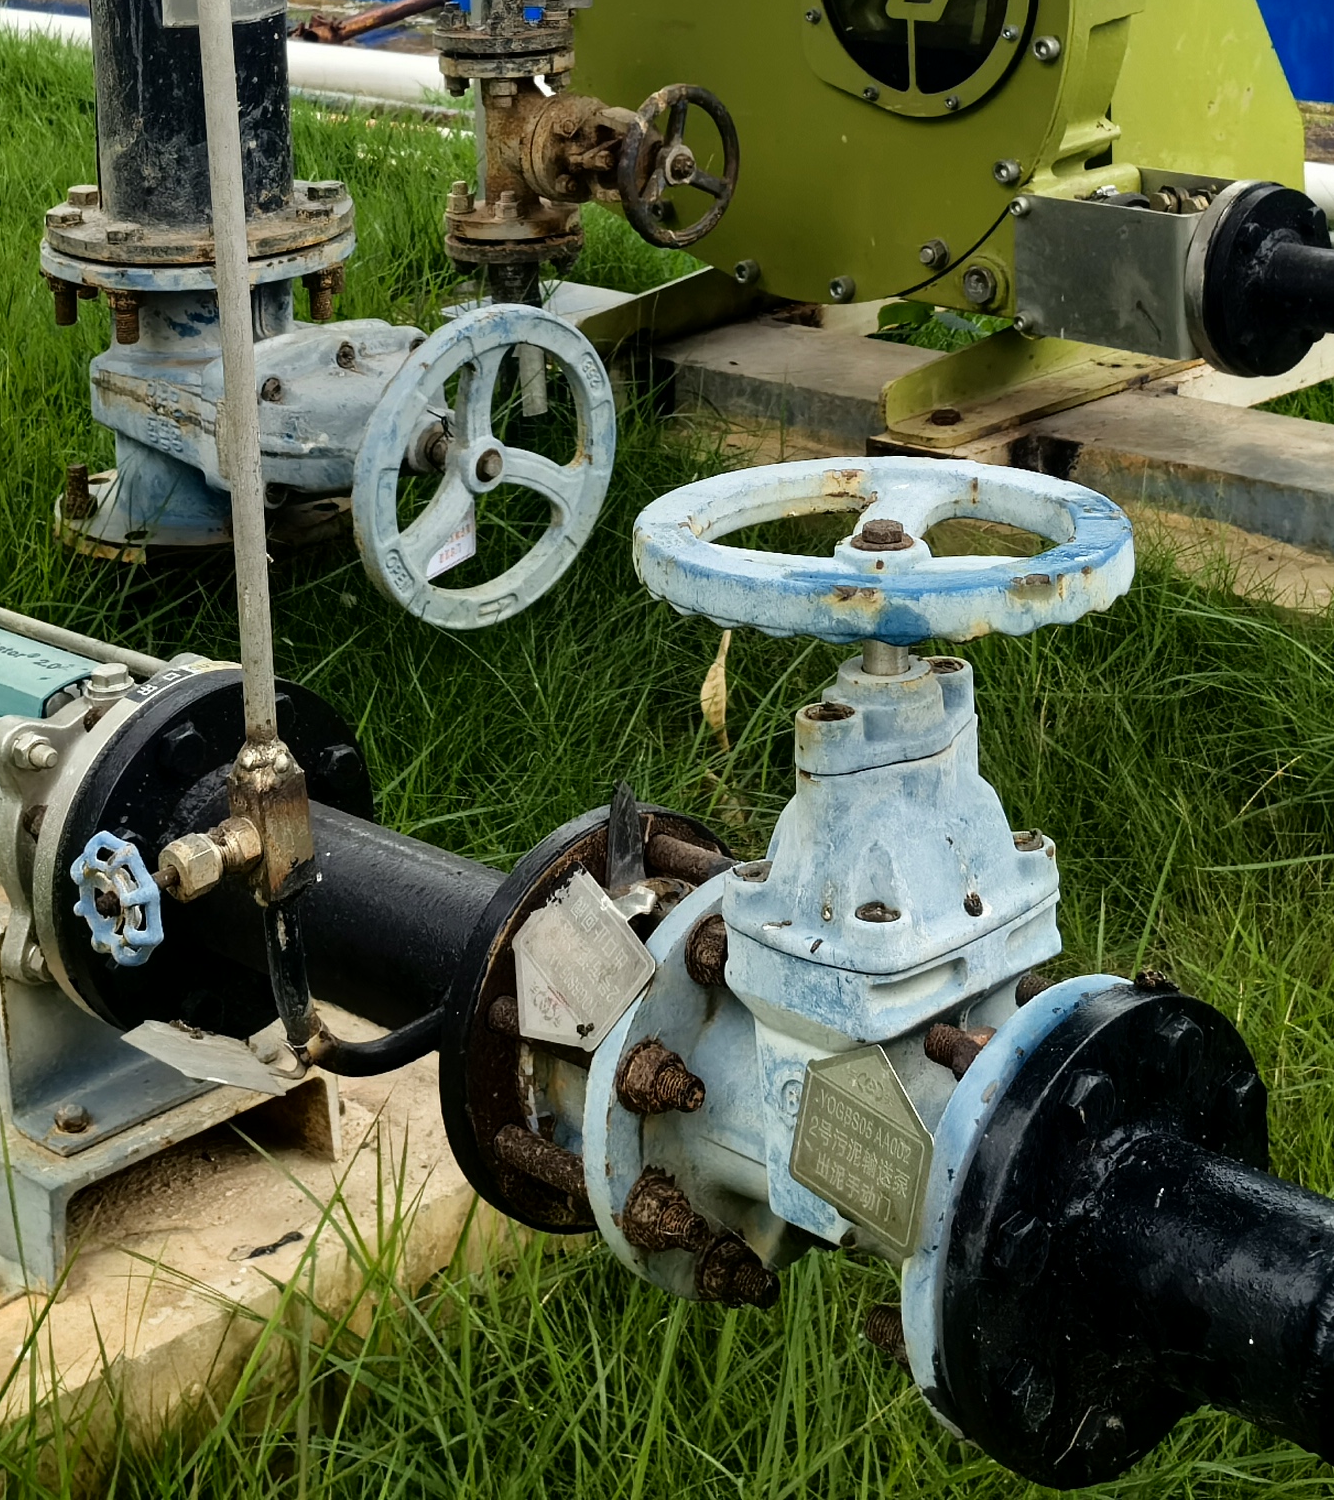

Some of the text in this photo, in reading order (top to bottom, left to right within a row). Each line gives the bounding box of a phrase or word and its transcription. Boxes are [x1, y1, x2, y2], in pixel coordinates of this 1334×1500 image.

[808, 1115, 911, 1200] 2号污泥输送泵
[815, 1152, 892, 1223] 出泥手动门
